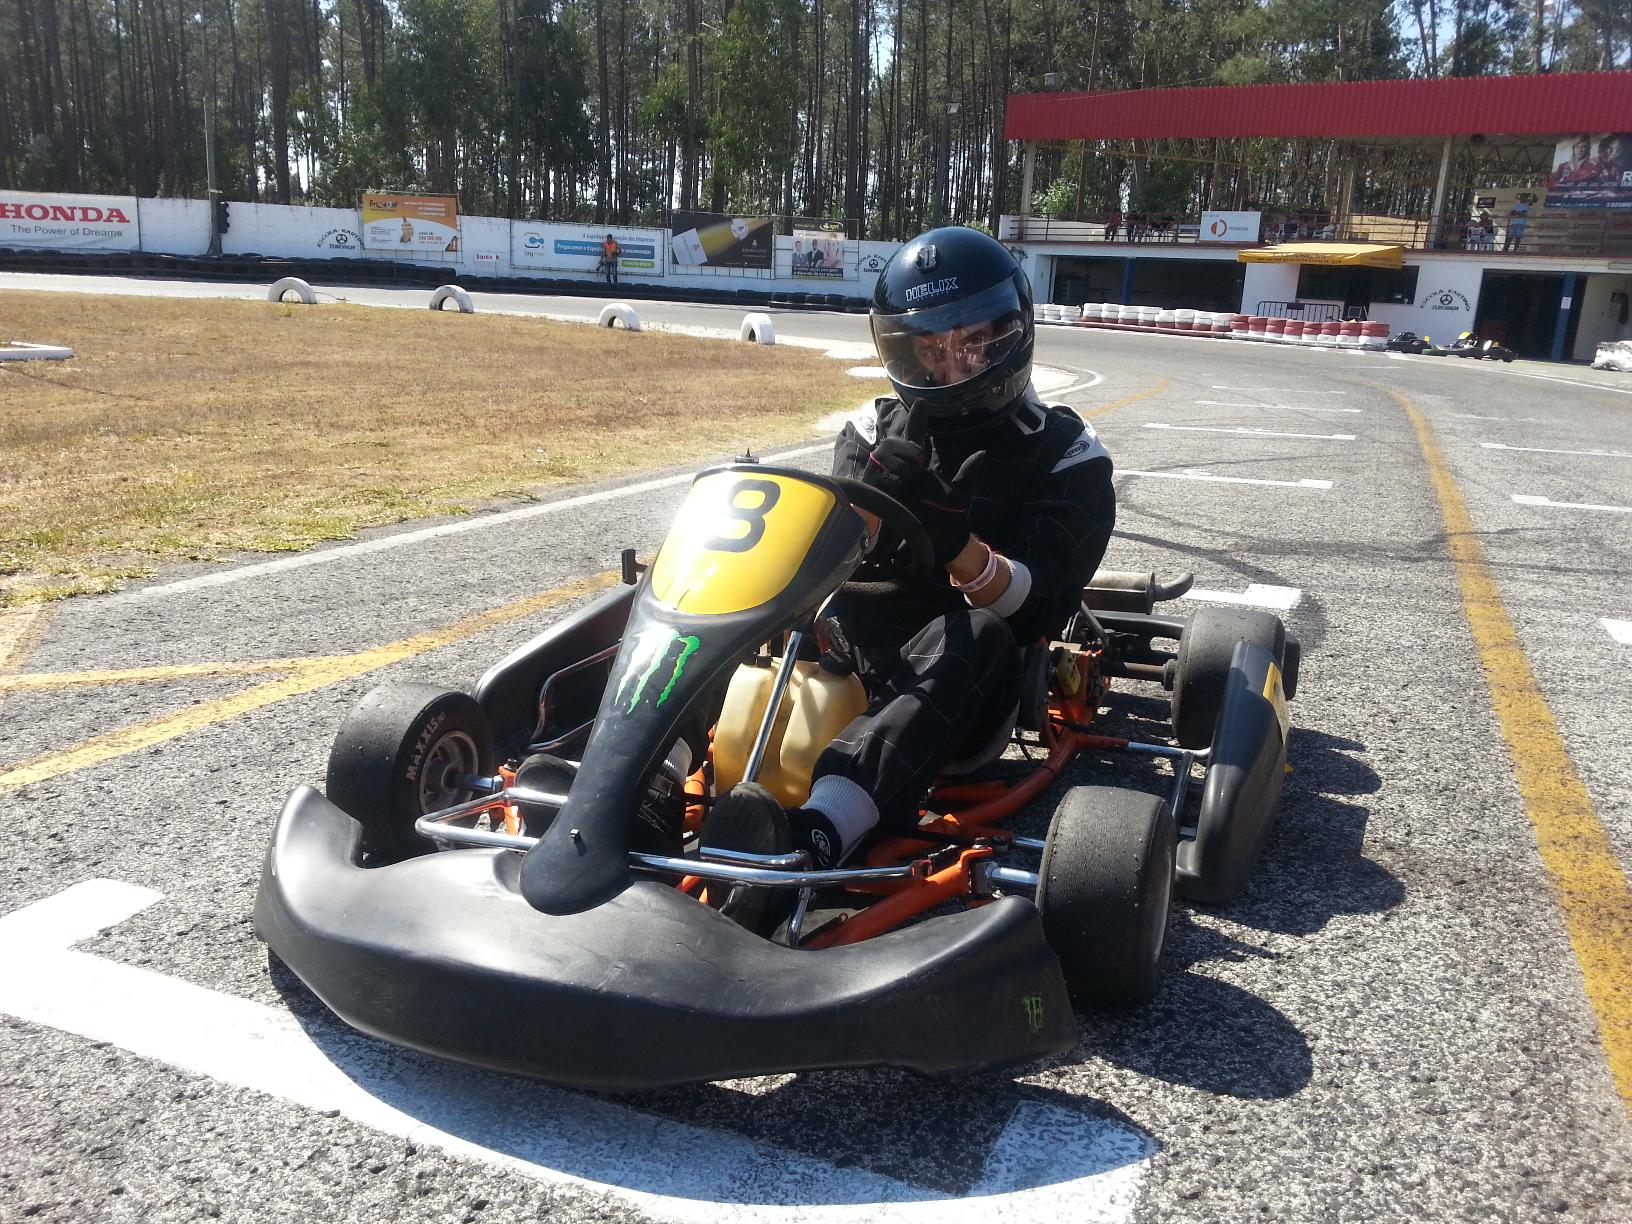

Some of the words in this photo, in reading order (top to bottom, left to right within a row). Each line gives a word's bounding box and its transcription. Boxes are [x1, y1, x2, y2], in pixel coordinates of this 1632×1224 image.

[0, 203, 130, 223] HONDA
[11, 224, 31, 234] The
[34, 225, 66, 236] Power
[70, 227, 79, 236] of
[82, 228, 122, 237] Dreams
[904, 276, 959, 302] HELIX
[405, 716, 440, 782] MAXXIS
